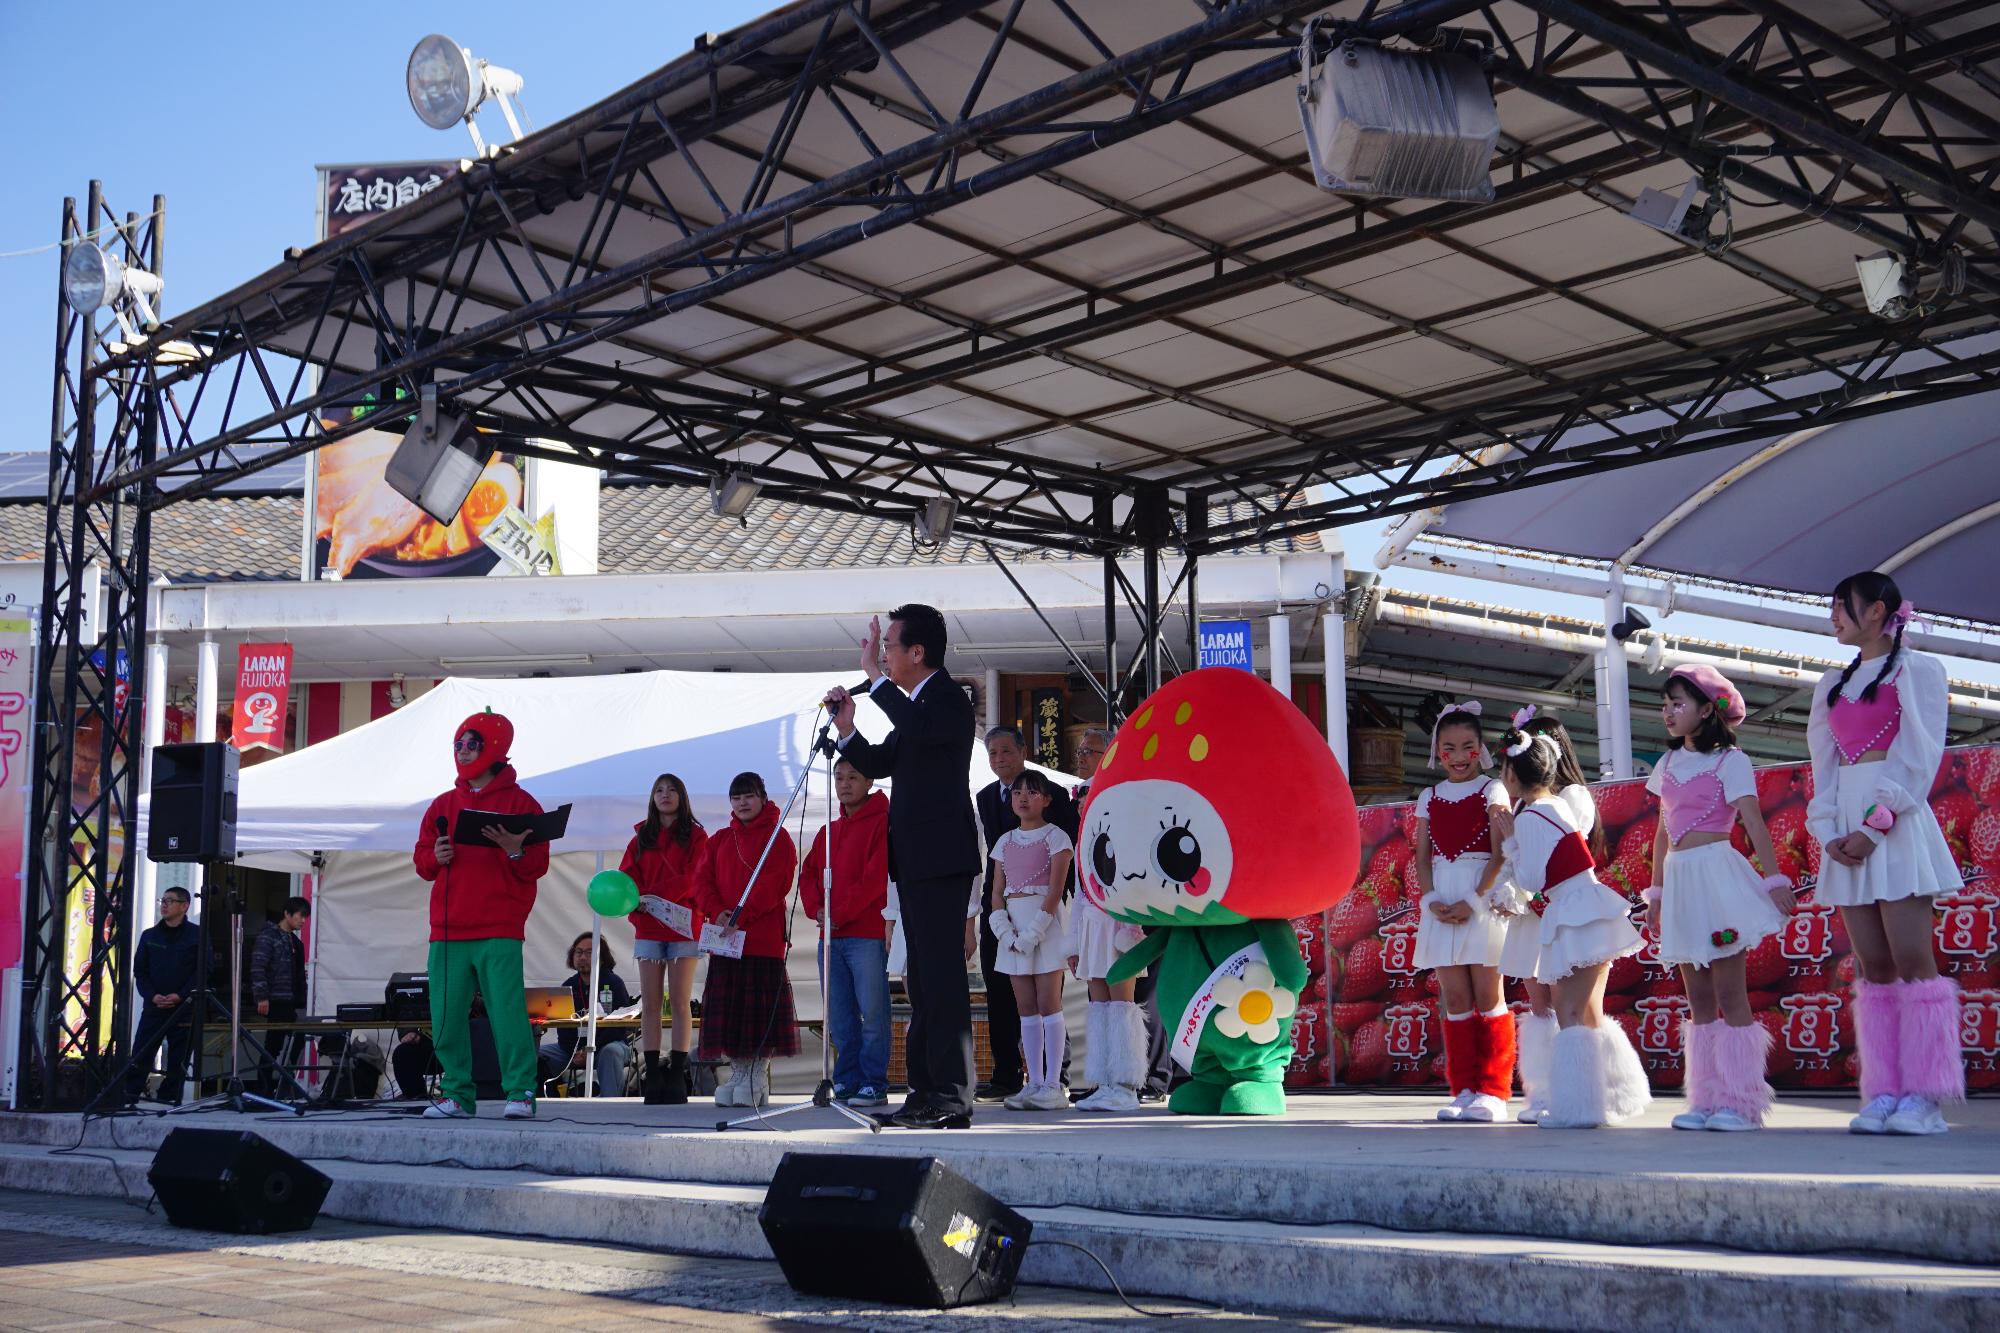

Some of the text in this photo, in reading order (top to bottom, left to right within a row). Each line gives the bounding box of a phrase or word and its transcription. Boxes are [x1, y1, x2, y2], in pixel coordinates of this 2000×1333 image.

[1200, 632, 1244, 649] LARAN
[244, 656, 285, 672] LARAN
[1200, 649, 1247, 666] FUJIOKA
[241, 672, 286, 688] FUJIOKA
[1788, 965, 1823, 977] フェス
[1948, 960, 1988, 973] フェス
[1643, 970, 1676, 981] フェス
[1388, 978, 1415, 989] フェス
[1393, 1062, 1420, 1072] フェス
[1648, 1059, 1680, 1070] フェス
[1793, 1058, 1831, 1071] フェス
